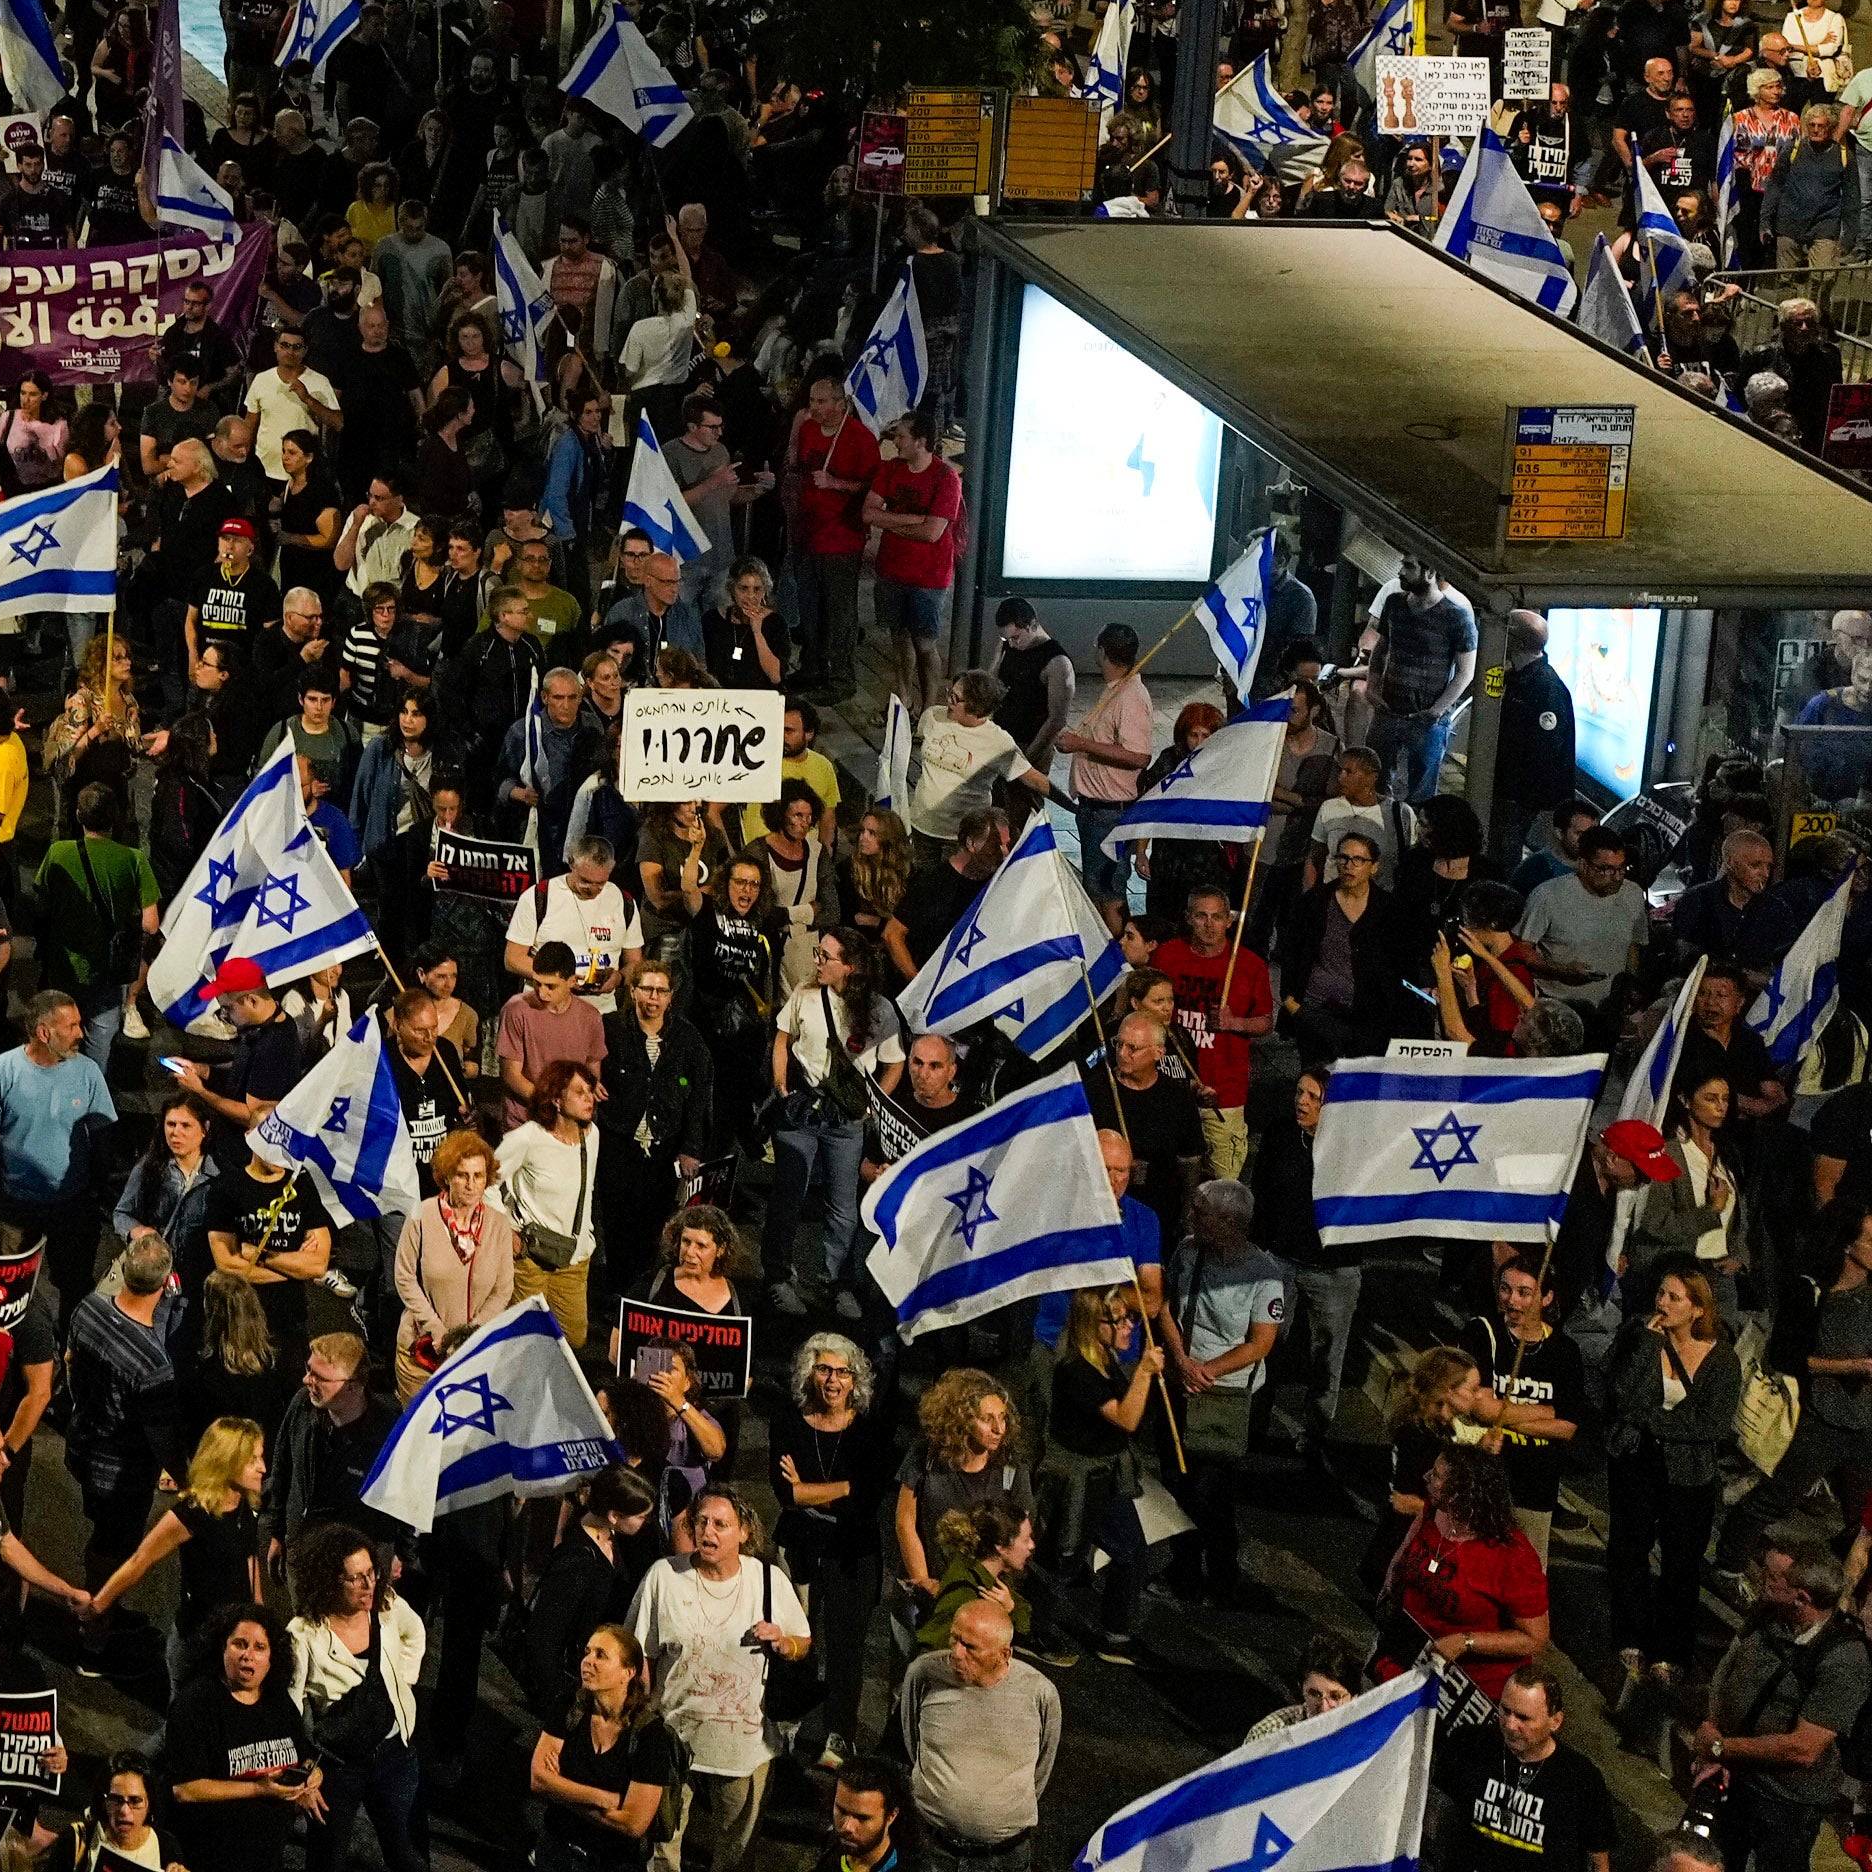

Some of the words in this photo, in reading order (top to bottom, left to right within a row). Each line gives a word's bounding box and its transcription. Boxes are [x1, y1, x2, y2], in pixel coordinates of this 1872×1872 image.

[88, 240, 236, 291] עסקה
[1515, 463, 1539, 474] 635
[1514, 494, 1539, 504] 280
[1512, 509, 1538, 519] 477
[1511, 524, 1537, 535] 478
[206, 588, 246, 606] בוחרים
[200, 603, 248, 622] בחטופים
[1799, 817, 1833, 833] 200
[460, 850, 502, 868] תתנו
[503, 854, 528, 870] אל
[1398, 1046, 1453, 1059] הפסקת
[628, 1312, 665, 1338] אותו
[667, 1319, 742, 1347] מחליפים
[228, 1755, 267, 1777] FAMILIES
[267, 1747, 302, 1771] FORUM
